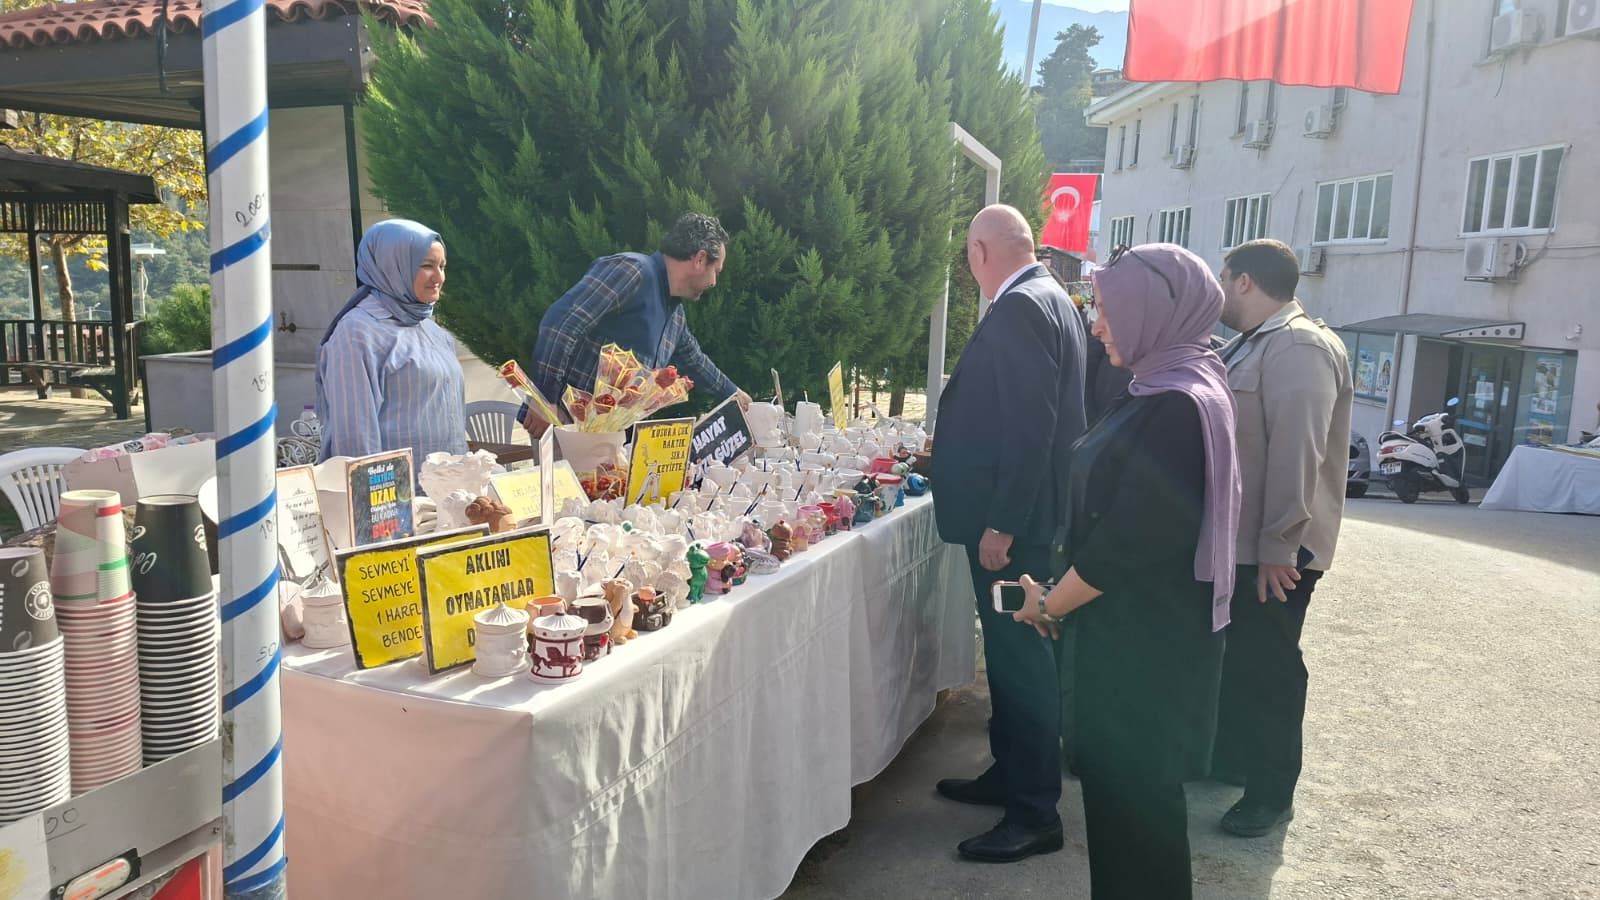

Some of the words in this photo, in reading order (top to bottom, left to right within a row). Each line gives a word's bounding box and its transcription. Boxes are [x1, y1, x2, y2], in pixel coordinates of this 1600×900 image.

[692, 415, 727, 454] HAYAT
[714, 429, 747, 461] GÜZEL
[370, 486, 397, 507] UZAK
[466, 548, 511, 575] AKLINI
[445, 577, 535, 615] OYNATANLAR
[376, 611, 382, 625] 1
[385, 602, 422, 622] HARFL
[382, 625, 424, 648] BENDE
